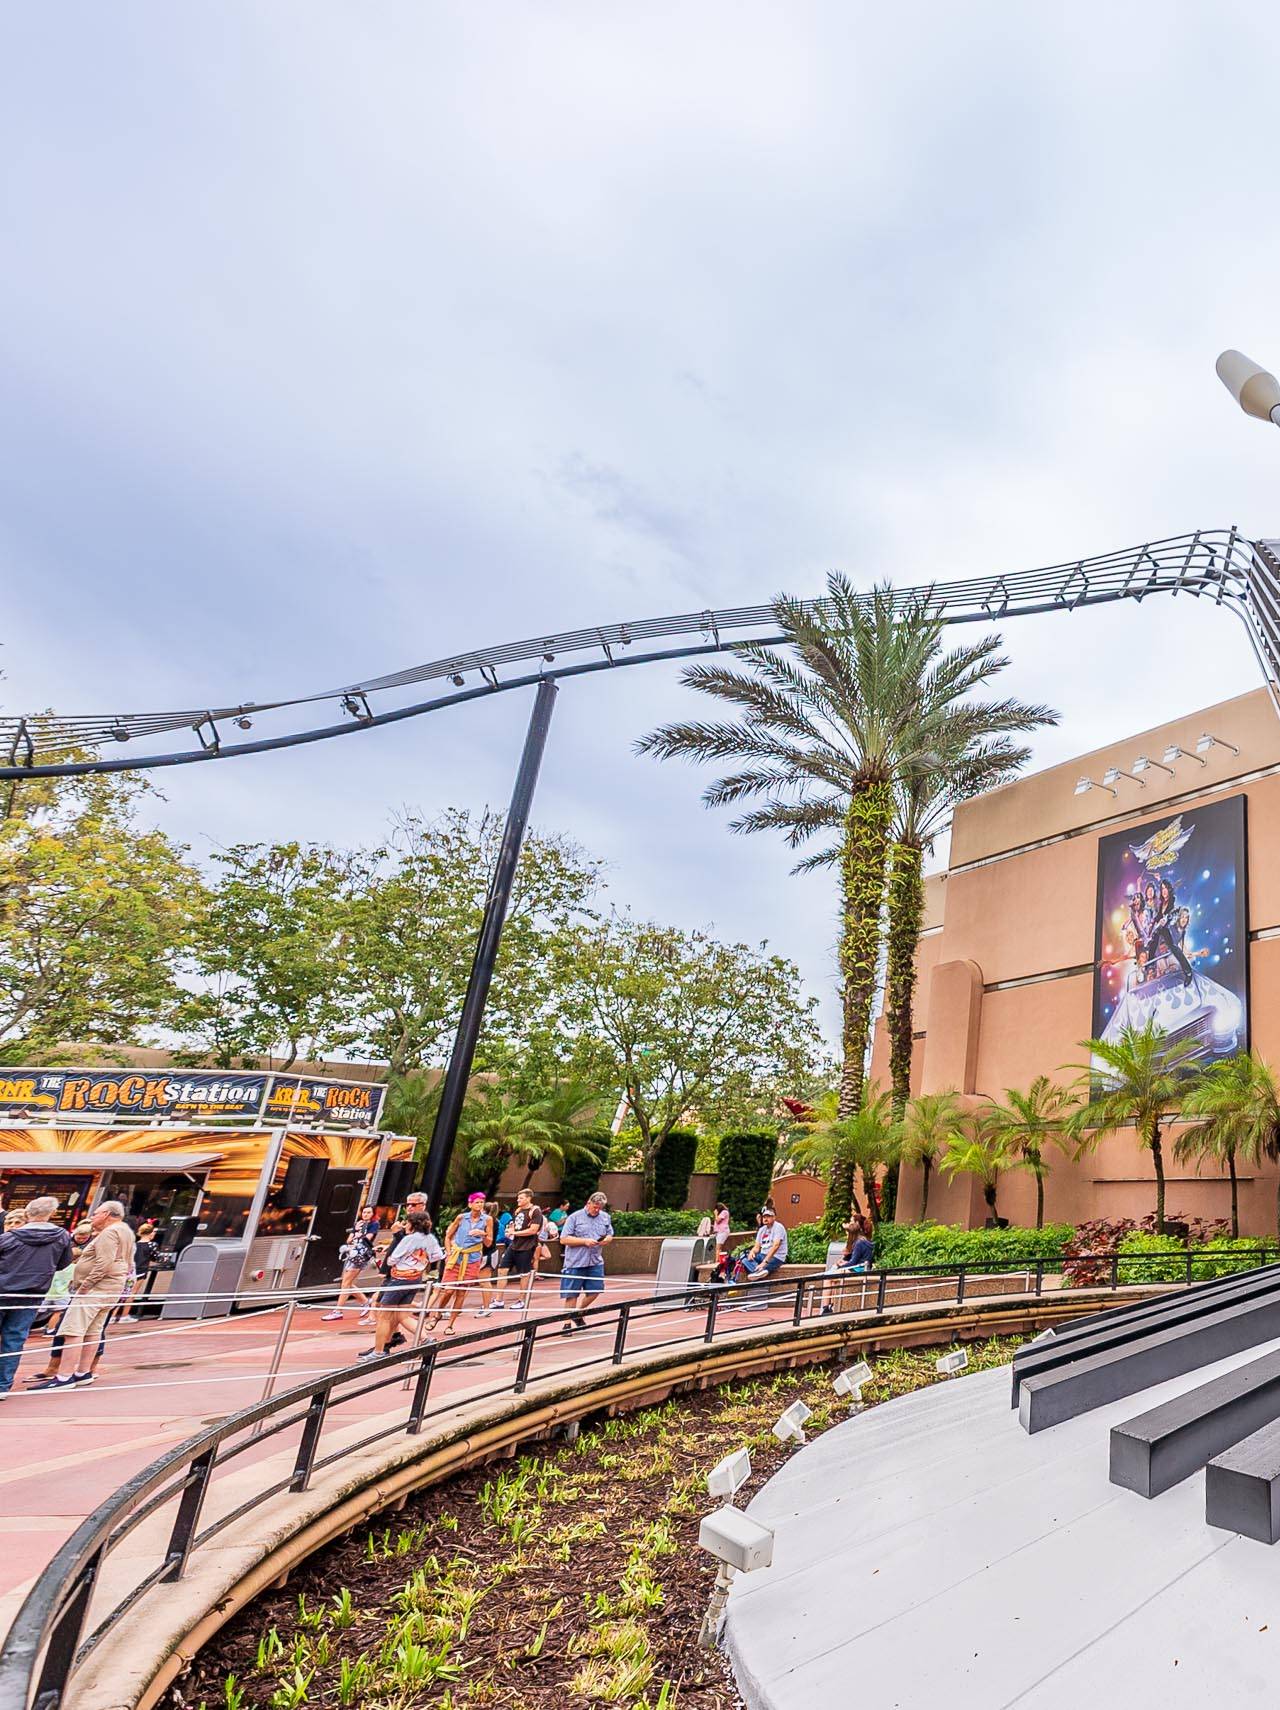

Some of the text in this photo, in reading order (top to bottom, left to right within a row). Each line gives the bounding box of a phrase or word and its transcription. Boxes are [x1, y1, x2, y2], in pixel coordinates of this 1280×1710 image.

[41, 1077, 62, 1088] THE
[59, 1076, 171, 1111] ROCK
[165, 1082, 258, 1102] Station
[274, 1086, 310, 1104] KRR
[325, 1087, 371, 1109] ROCK
[330, 1107, 372, 1121] Station
